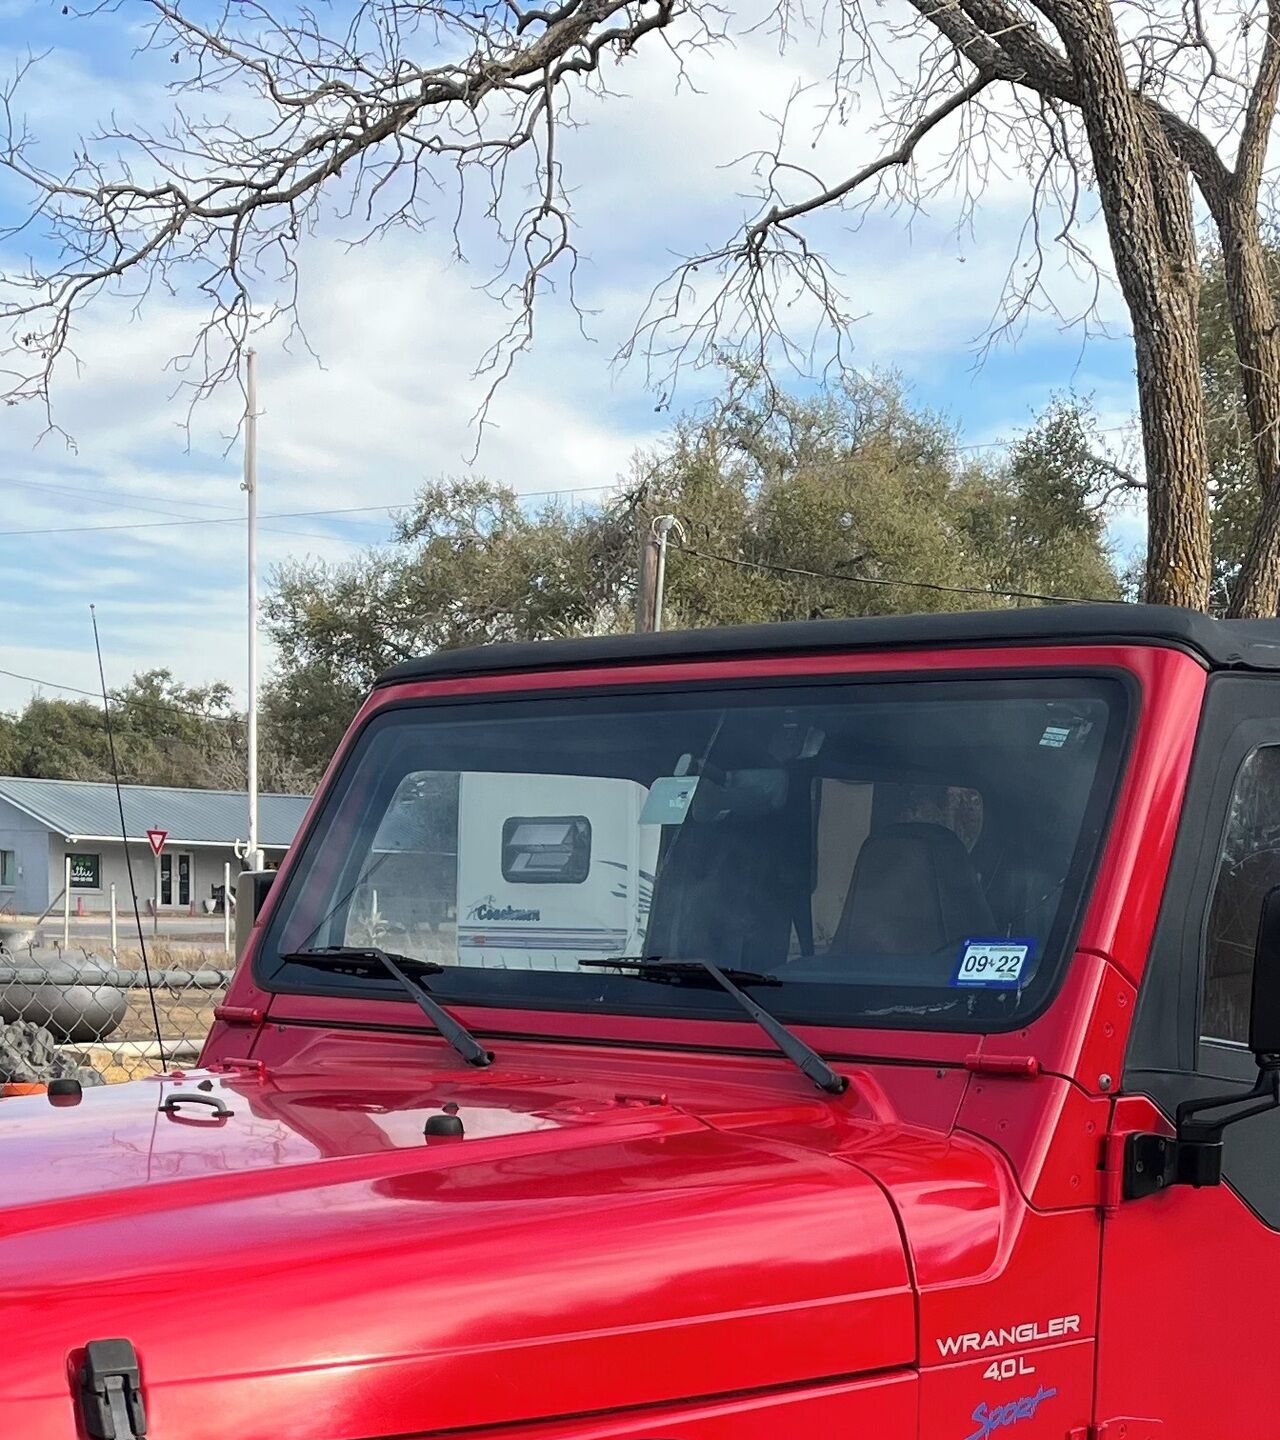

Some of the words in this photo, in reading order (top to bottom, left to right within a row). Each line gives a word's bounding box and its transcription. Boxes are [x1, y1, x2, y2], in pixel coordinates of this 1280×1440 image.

[964, 955, 988, 973] 09
[995, 955, 1021, 973] 22
[936, 1314, 1080, 1357] WRANGLER
